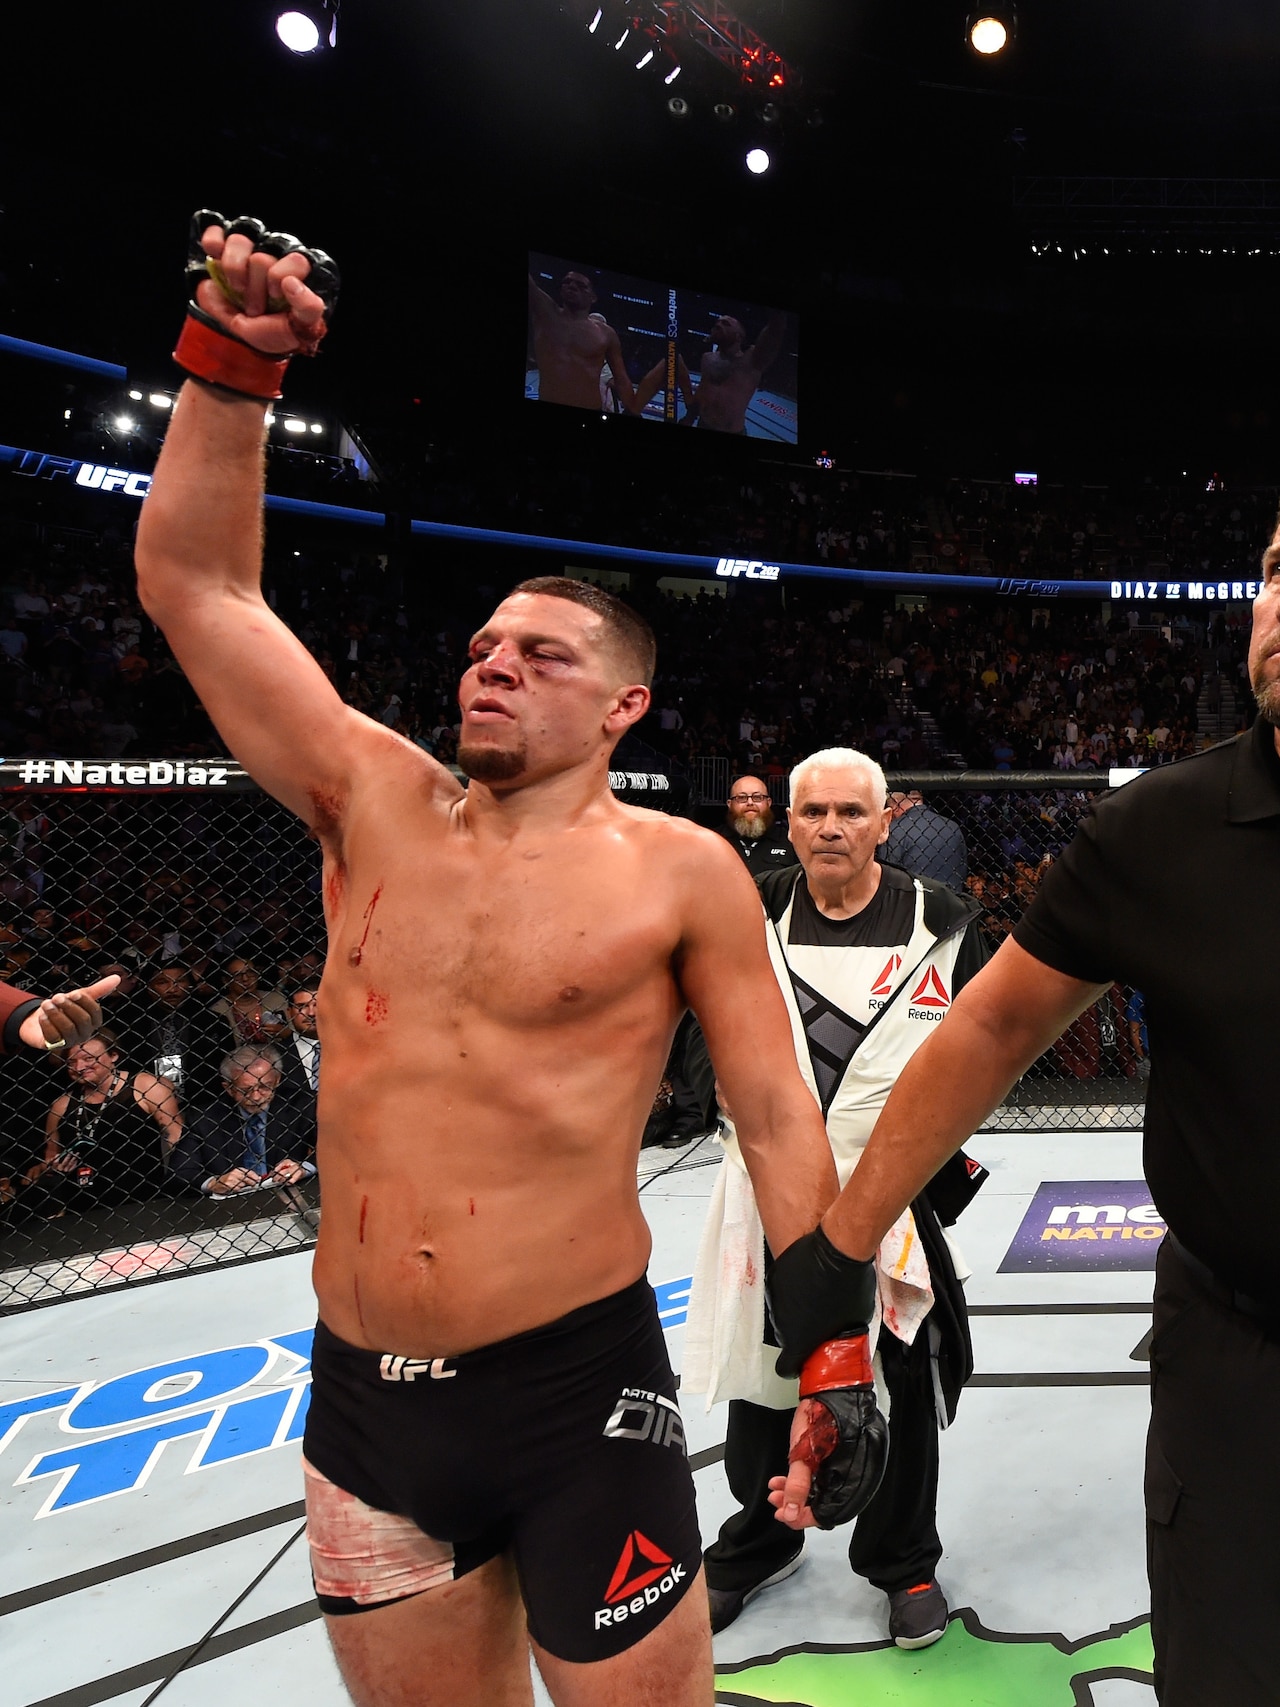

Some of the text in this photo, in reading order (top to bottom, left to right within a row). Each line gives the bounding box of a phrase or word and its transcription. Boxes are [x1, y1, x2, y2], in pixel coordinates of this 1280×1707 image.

[1111, 581, 1157, 599] DIAZ
[1188, 582, 1265, 600] McGRE
[19, 760, 227, 785] #NateDiaz
[770, 848, 787, 856] UFC
[908, 1008, 946, 1021] Reebo
[1041, 1226, 1168, 1241] NATIO
[379, 1354, 457, 1382] UFC
[622, 1388, 656, 1401] NATE
[602, 1399, 687, 1457] DIA
[594, 1563, 687, 1630] Reebok
